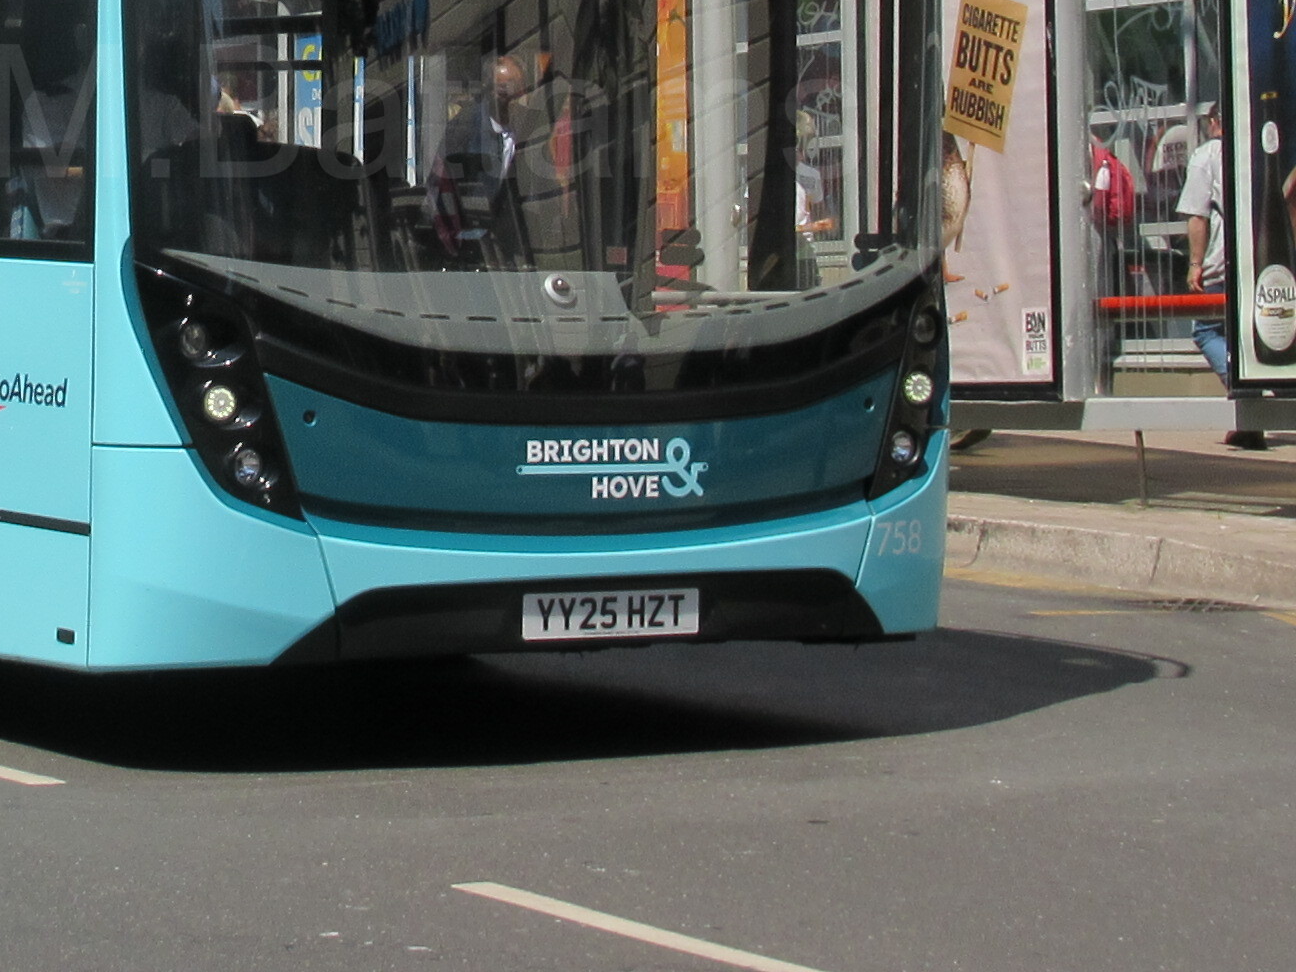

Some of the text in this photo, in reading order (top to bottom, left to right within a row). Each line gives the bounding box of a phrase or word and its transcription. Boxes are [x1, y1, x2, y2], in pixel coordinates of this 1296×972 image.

[962, 3, 1021, 43] CIGARETTE
[955, 30, 1015, 86] BUTTS
[968, 78, 994, 95] ARE
[950, 86, 1006, 131] RUBBISH
[1025, 312, 1046, 333] BAN
[526, 438, 660, 463] BRIGHTON
[591, 475, 660, 499] HOVE
[877, 519, 922, 557] 758
[537, 594, 685, 631] YY25 HZT
